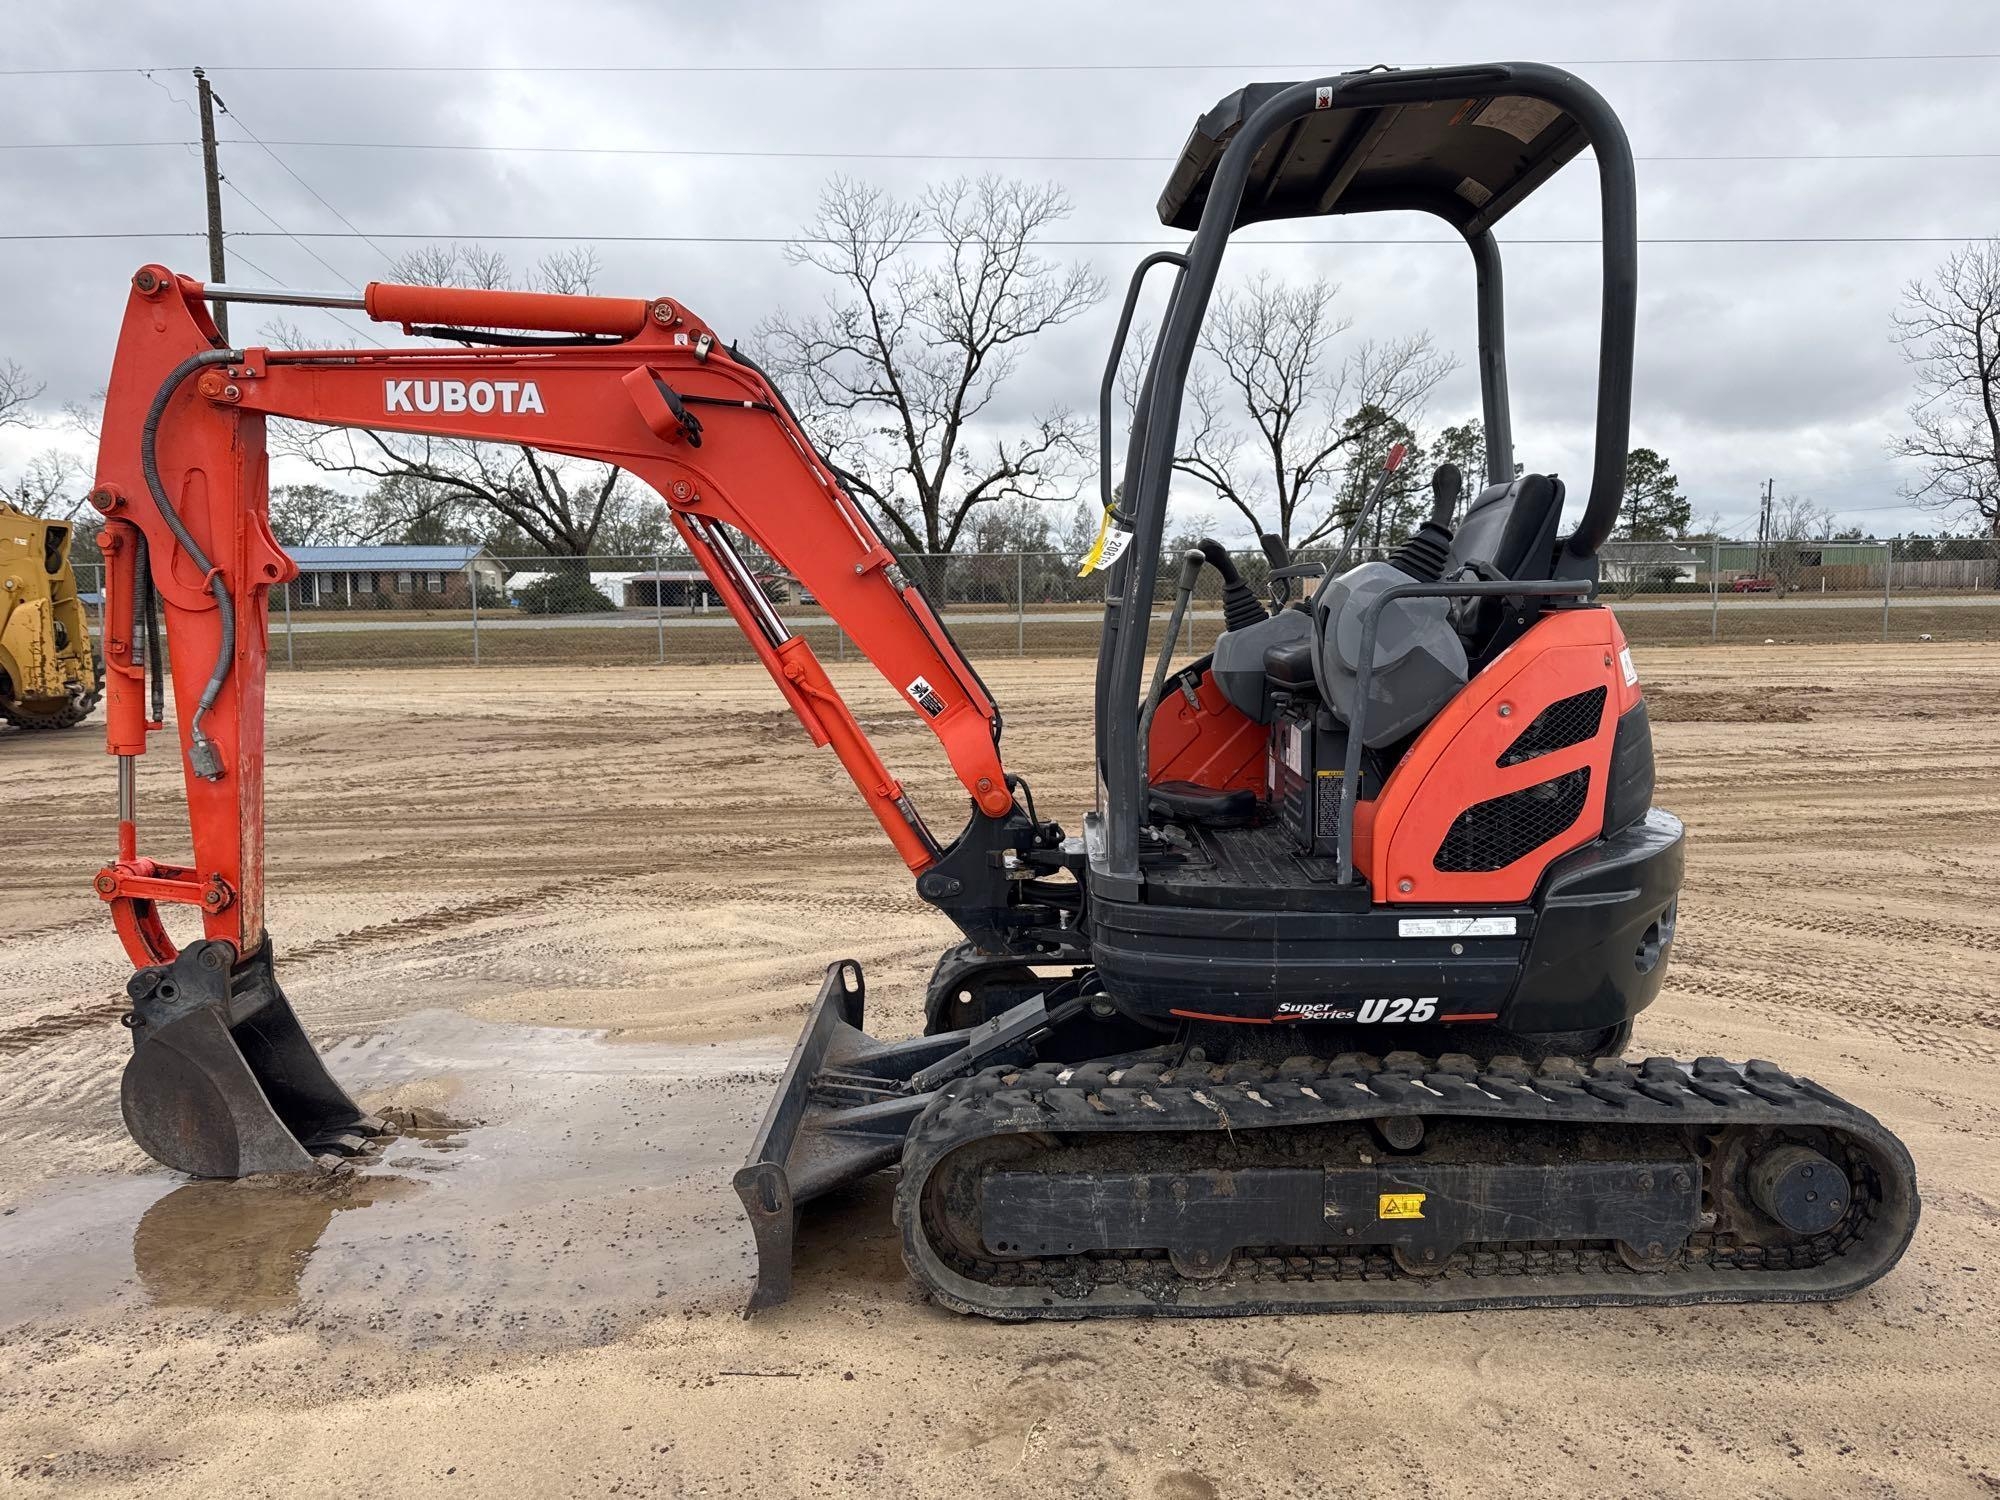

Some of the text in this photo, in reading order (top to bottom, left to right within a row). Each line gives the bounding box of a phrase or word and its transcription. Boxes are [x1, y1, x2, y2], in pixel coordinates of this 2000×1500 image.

[385, 380, 545, 414] KUBOTA
[1277, 1002, 1333, 1015] Super
[1302, 1009, 1355, 1020] Series
[1356, 997, 1439, 1024] U25
